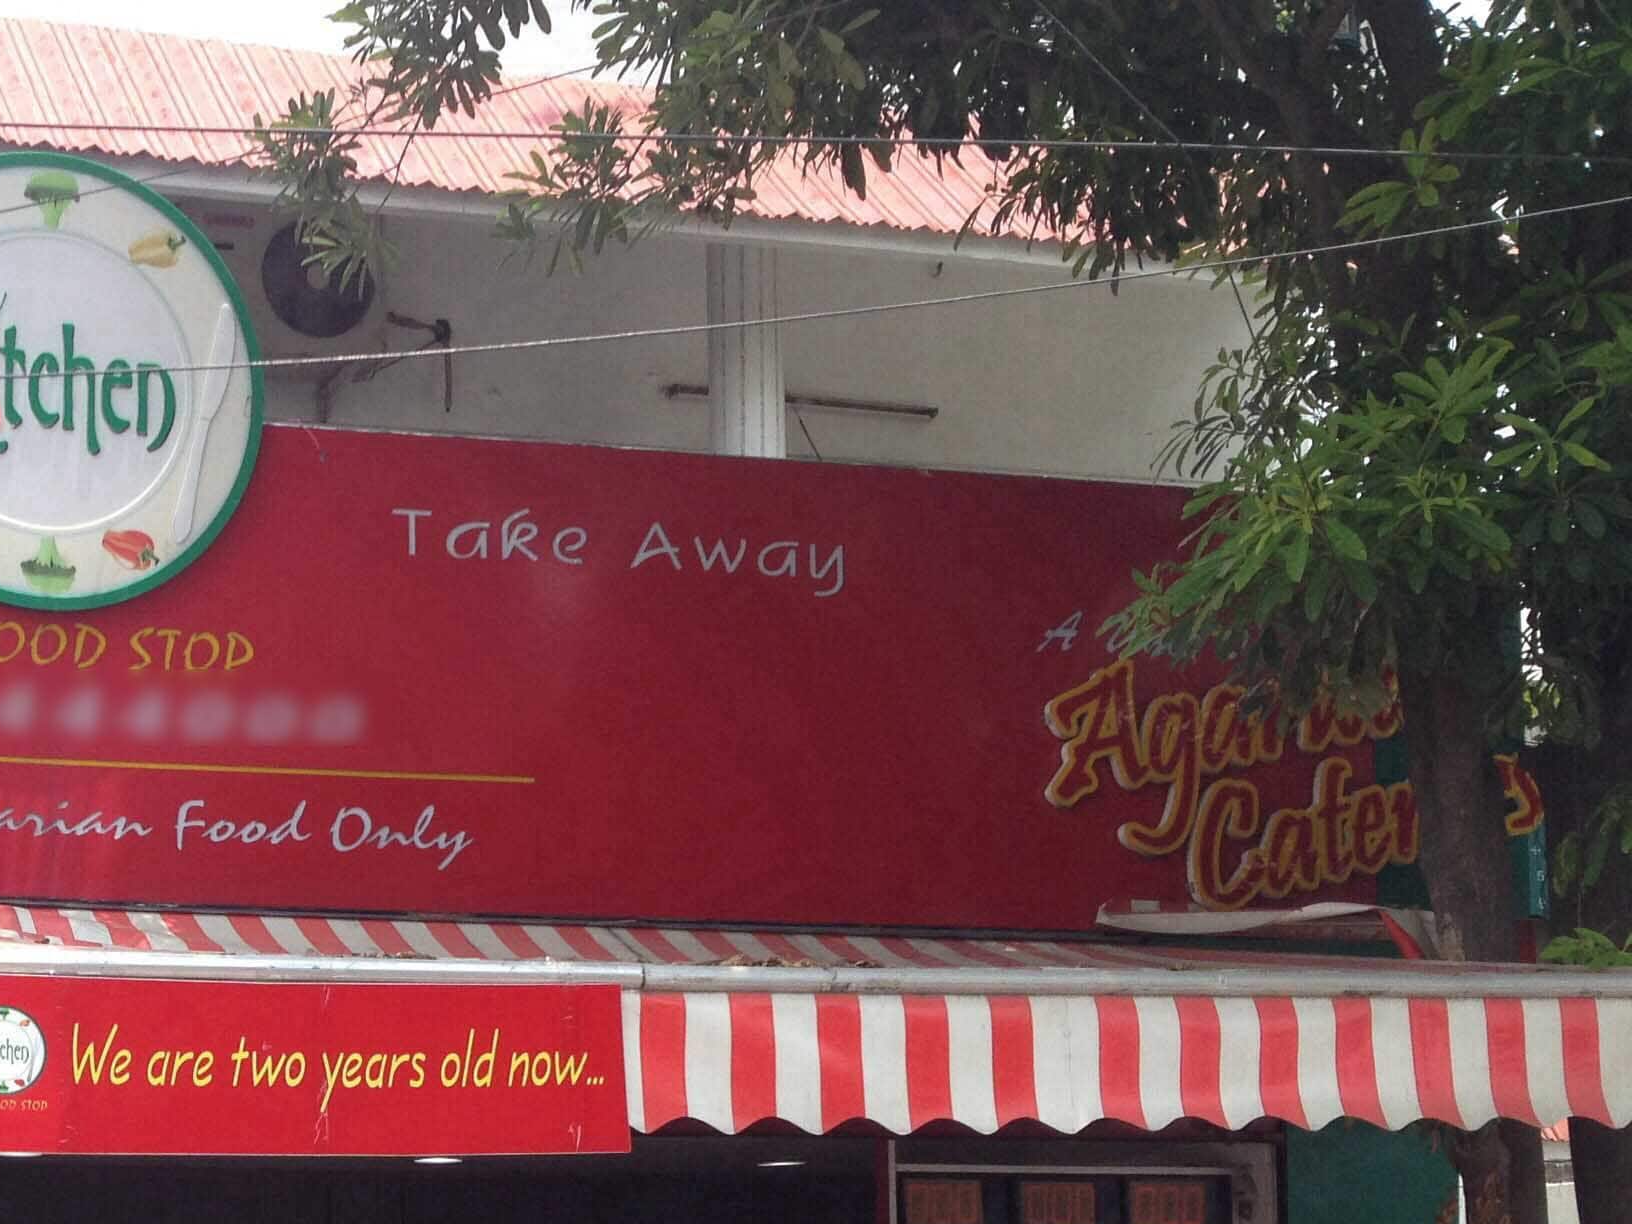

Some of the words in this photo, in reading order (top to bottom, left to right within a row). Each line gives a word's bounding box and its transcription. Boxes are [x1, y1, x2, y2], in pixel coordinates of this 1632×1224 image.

[391, 507, 590, 566] Take
[629, 521, 847, 598] Away
[126, 625, 254, 672] STOP
[173, 798, 315, 850] Food
[329, 803, 474, 873] Only
[21, 1099, 48, 1112] STOP
[71, 1022, 131, 1088] We
[145, 1046, 214, 1088] are
[229, 1036, 307, 1088] two
[320, 1045, 427, 1115] years
[438, 1027, 500, 1089] old
[507, 1048, 606, 1088] now...
